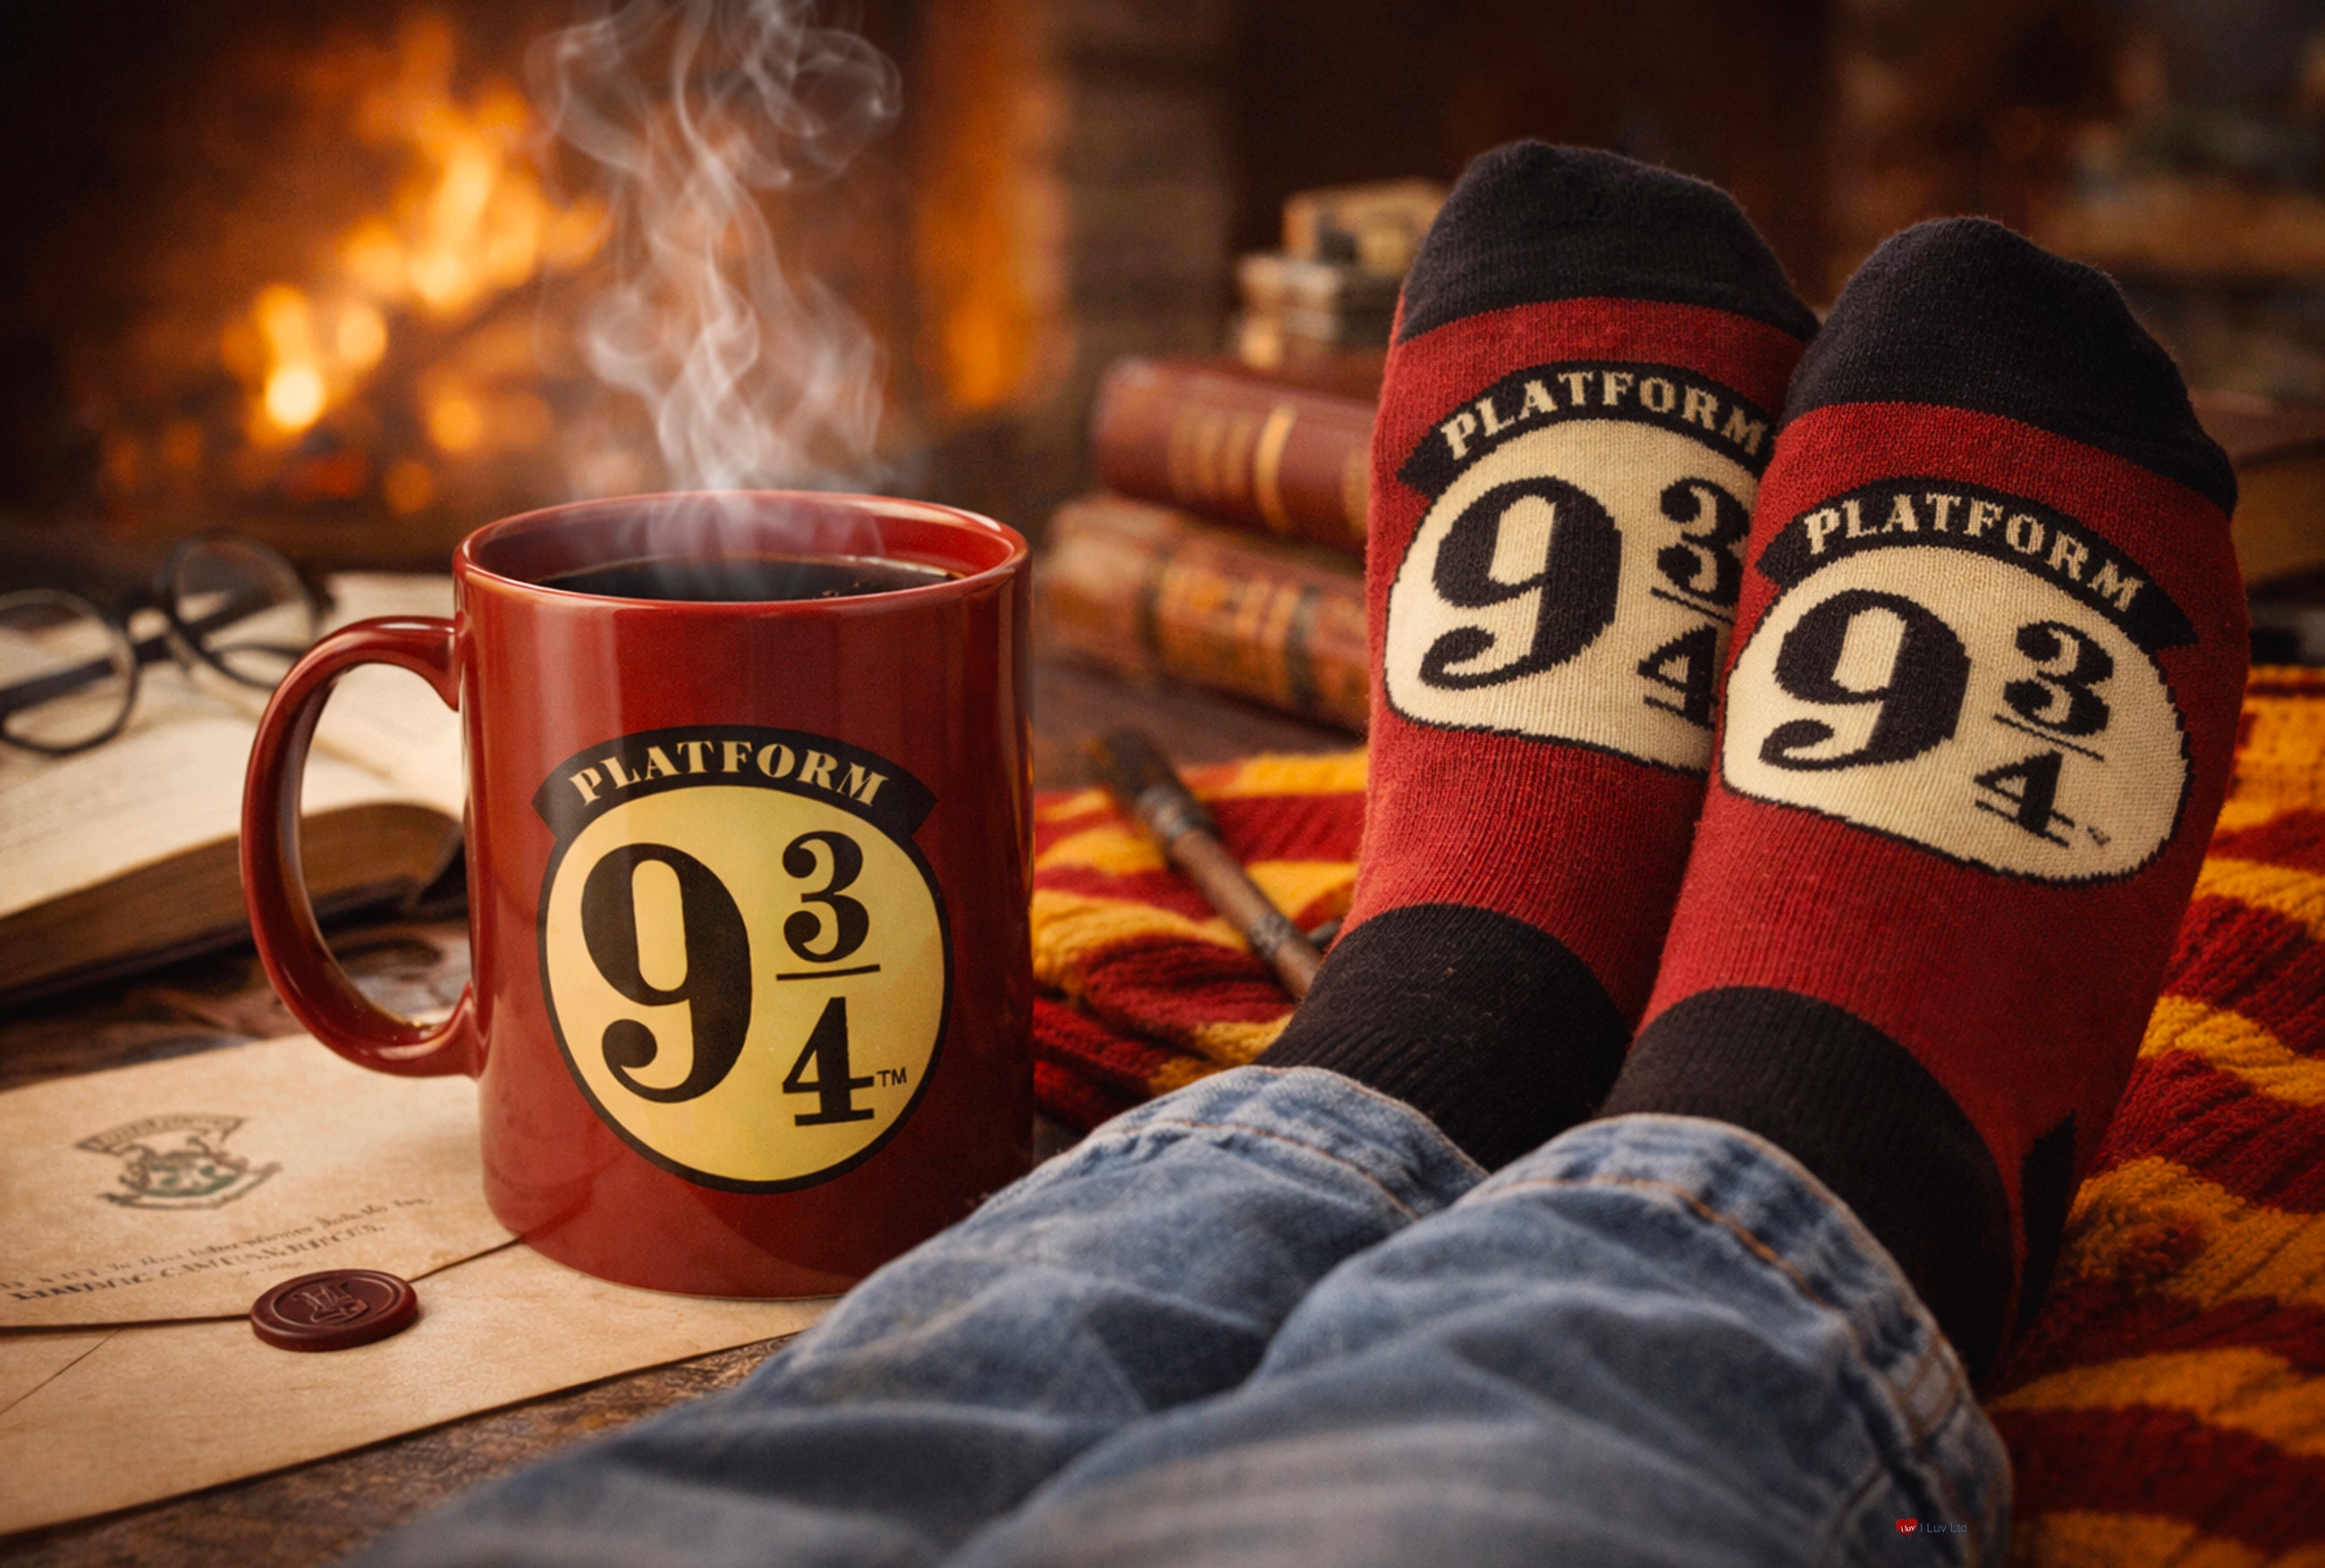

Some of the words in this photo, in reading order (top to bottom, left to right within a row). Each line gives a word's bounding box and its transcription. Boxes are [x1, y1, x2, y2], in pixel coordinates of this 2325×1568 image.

[1441, 371, 1767, 459] PLATFORM
[1418, 476, 1622, 691] 9
[1656, 476, 1751, 609] 3
[1804, 493, 2144, 613] PLATFORM
[1637, 623, 1719, 730] 4
[1759, 588, 1972, 771] 9
[2003, 620, 2114, 736] 3
[569, 740, 890, 806] PLATFORM
[1974, 749, 2075, 848] 4
[580, 842, 753, 1103] 9
[782, 830, 870, 963] 3
[782, 997, 875, 1126] 4
[876, 1067, 908, 1088] TM
